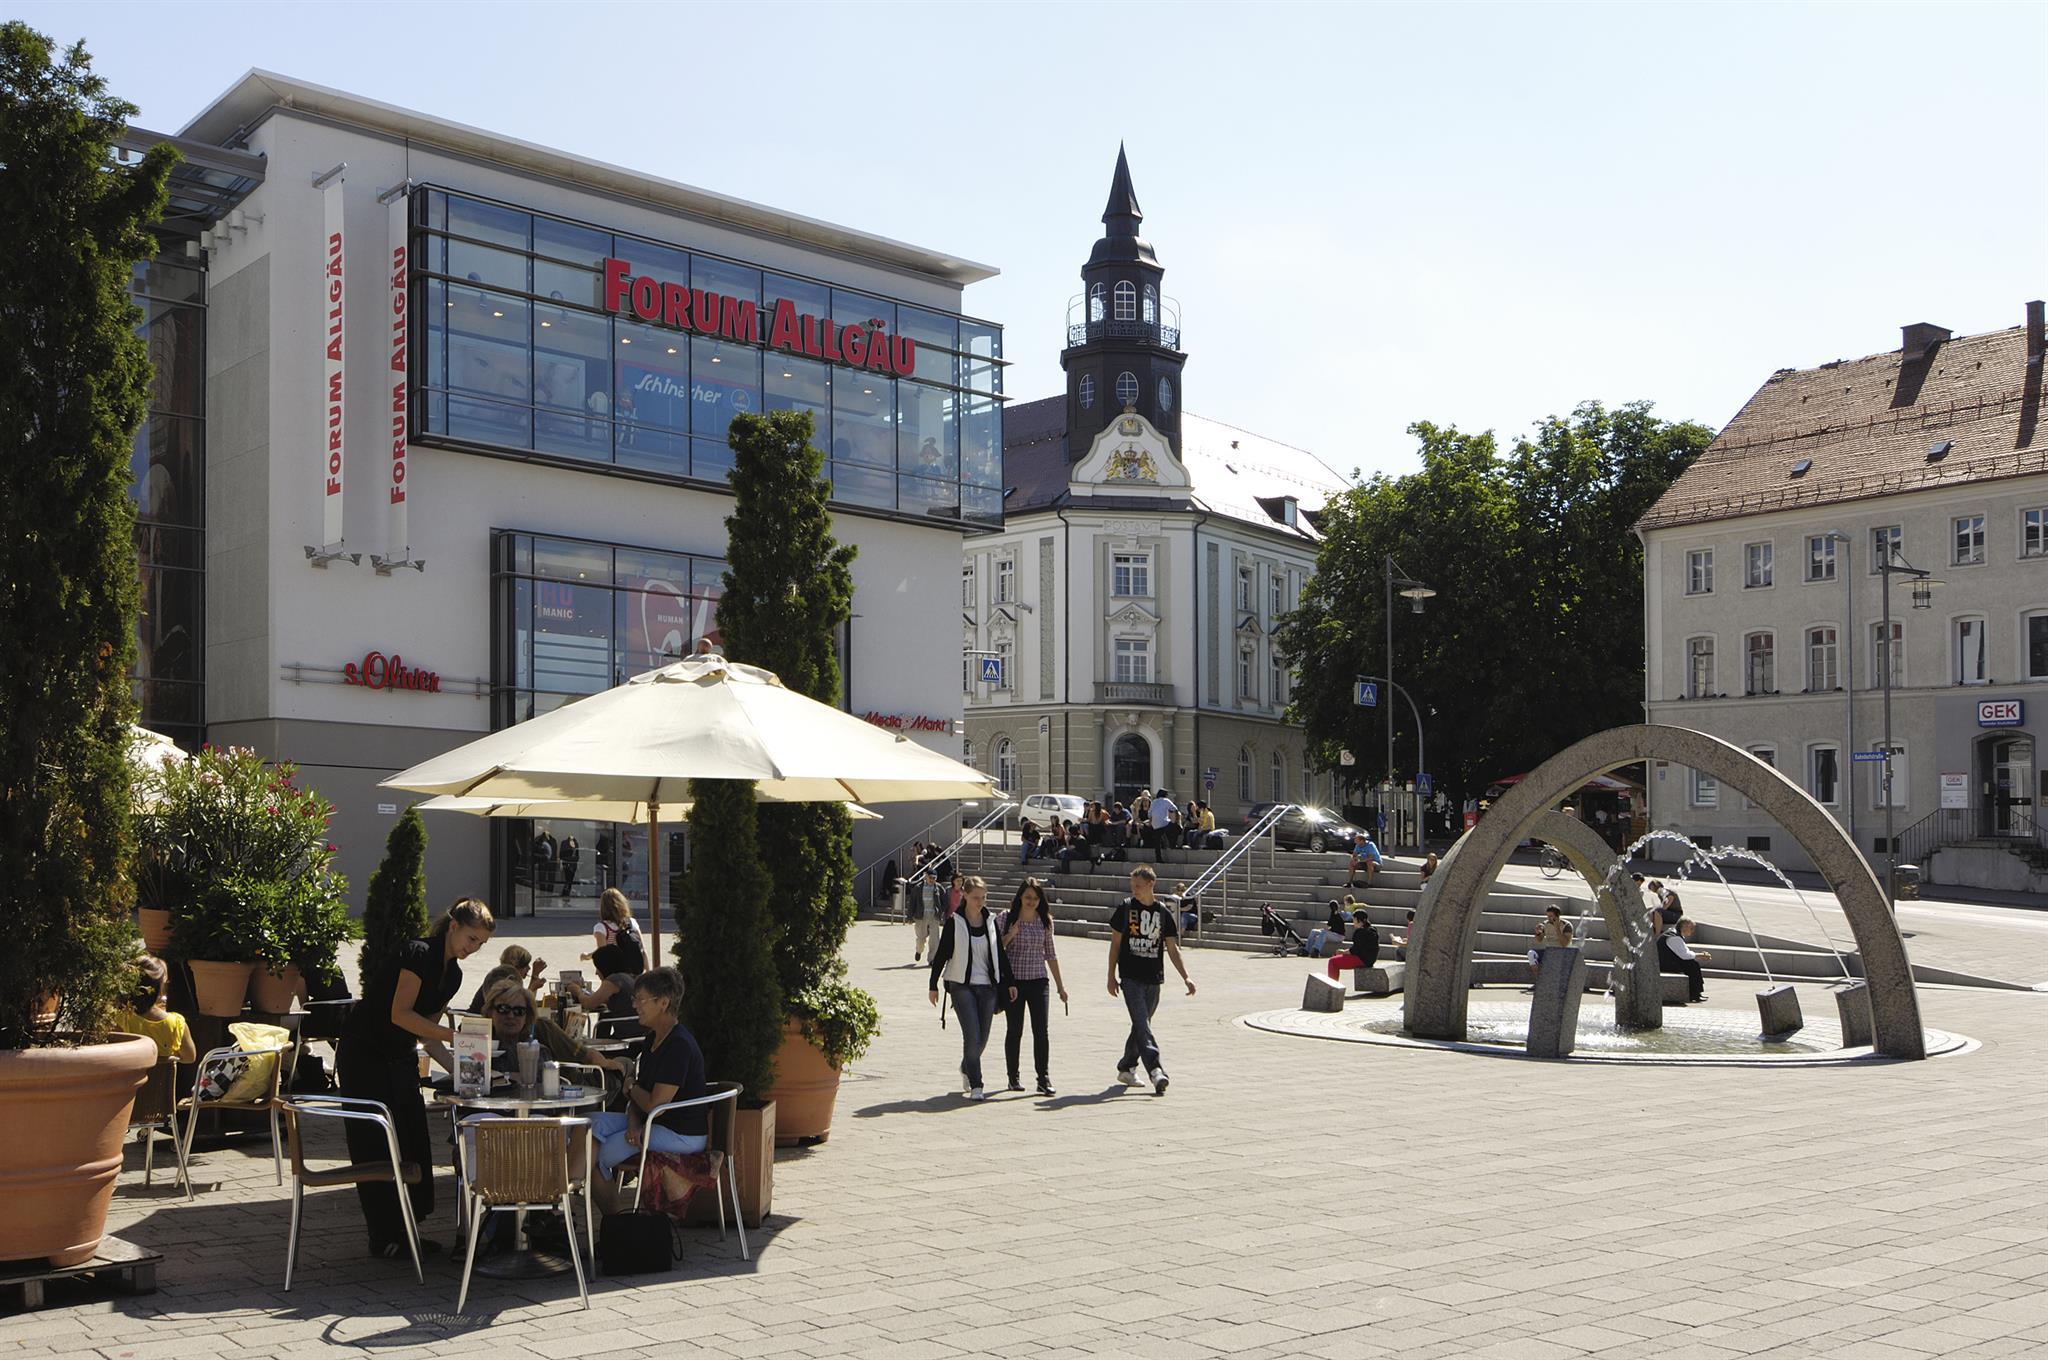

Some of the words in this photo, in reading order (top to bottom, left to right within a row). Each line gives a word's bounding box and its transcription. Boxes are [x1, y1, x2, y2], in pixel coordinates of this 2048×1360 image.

[326, 232, 342, 361] ALLGÄU
[390, 245, 406, 372] ALLGÄU
[603, 257, 758, 343] FORUM
[770, 297, 916, 376] ALLGÄU
[326, 371, 342, 497] FORUM
[390, 382, 406, 505] FORUM
[344, 651, 441, 693] s.Oliver
[542, 607, 574, 619] MANIC
[863, 711, 902, 728] Media
[910, 715, 946, 732] Markt
[1981, 704, 2017, 719] GEK
